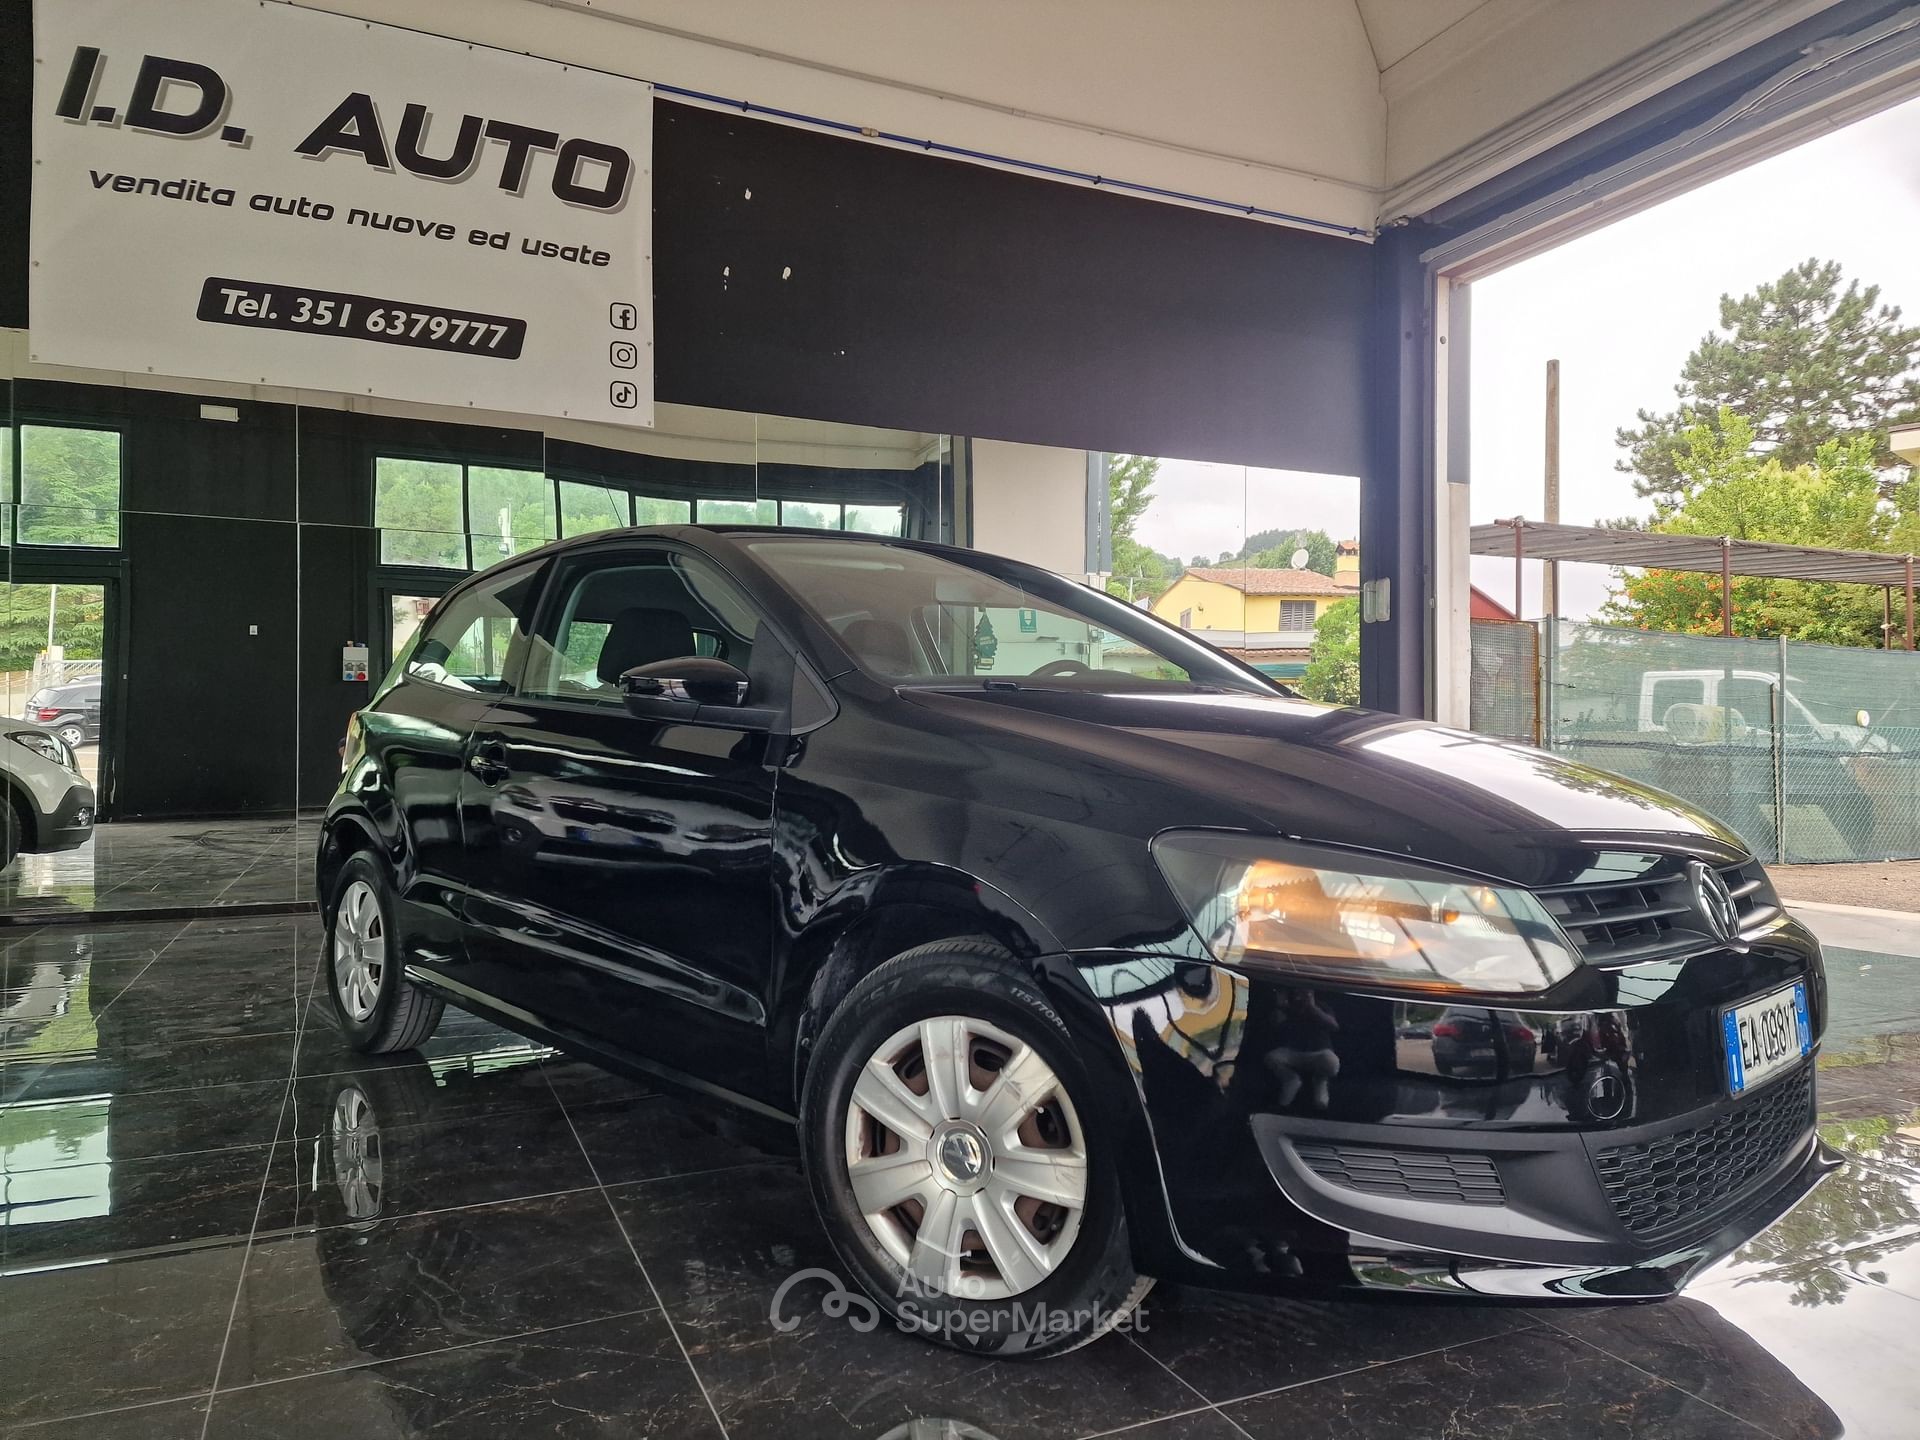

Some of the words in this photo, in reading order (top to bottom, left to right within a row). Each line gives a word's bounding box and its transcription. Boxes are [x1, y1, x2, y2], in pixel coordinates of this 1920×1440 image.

[55, 45, 252, 148] I.D.
[293, 92, 635, 214] AUTO
[89, 169, 236, 207] vendita
[249, 193, 335, 221] auto
[346, 207, 456, 241] nuove
[467, 231, 511, 251] ed
[520, 237, 611, 267] usate
[220, 288, 278, 320] Tel.
[290, 297, 352, 328] 351
[365, 308, 509, 350] 6379777
